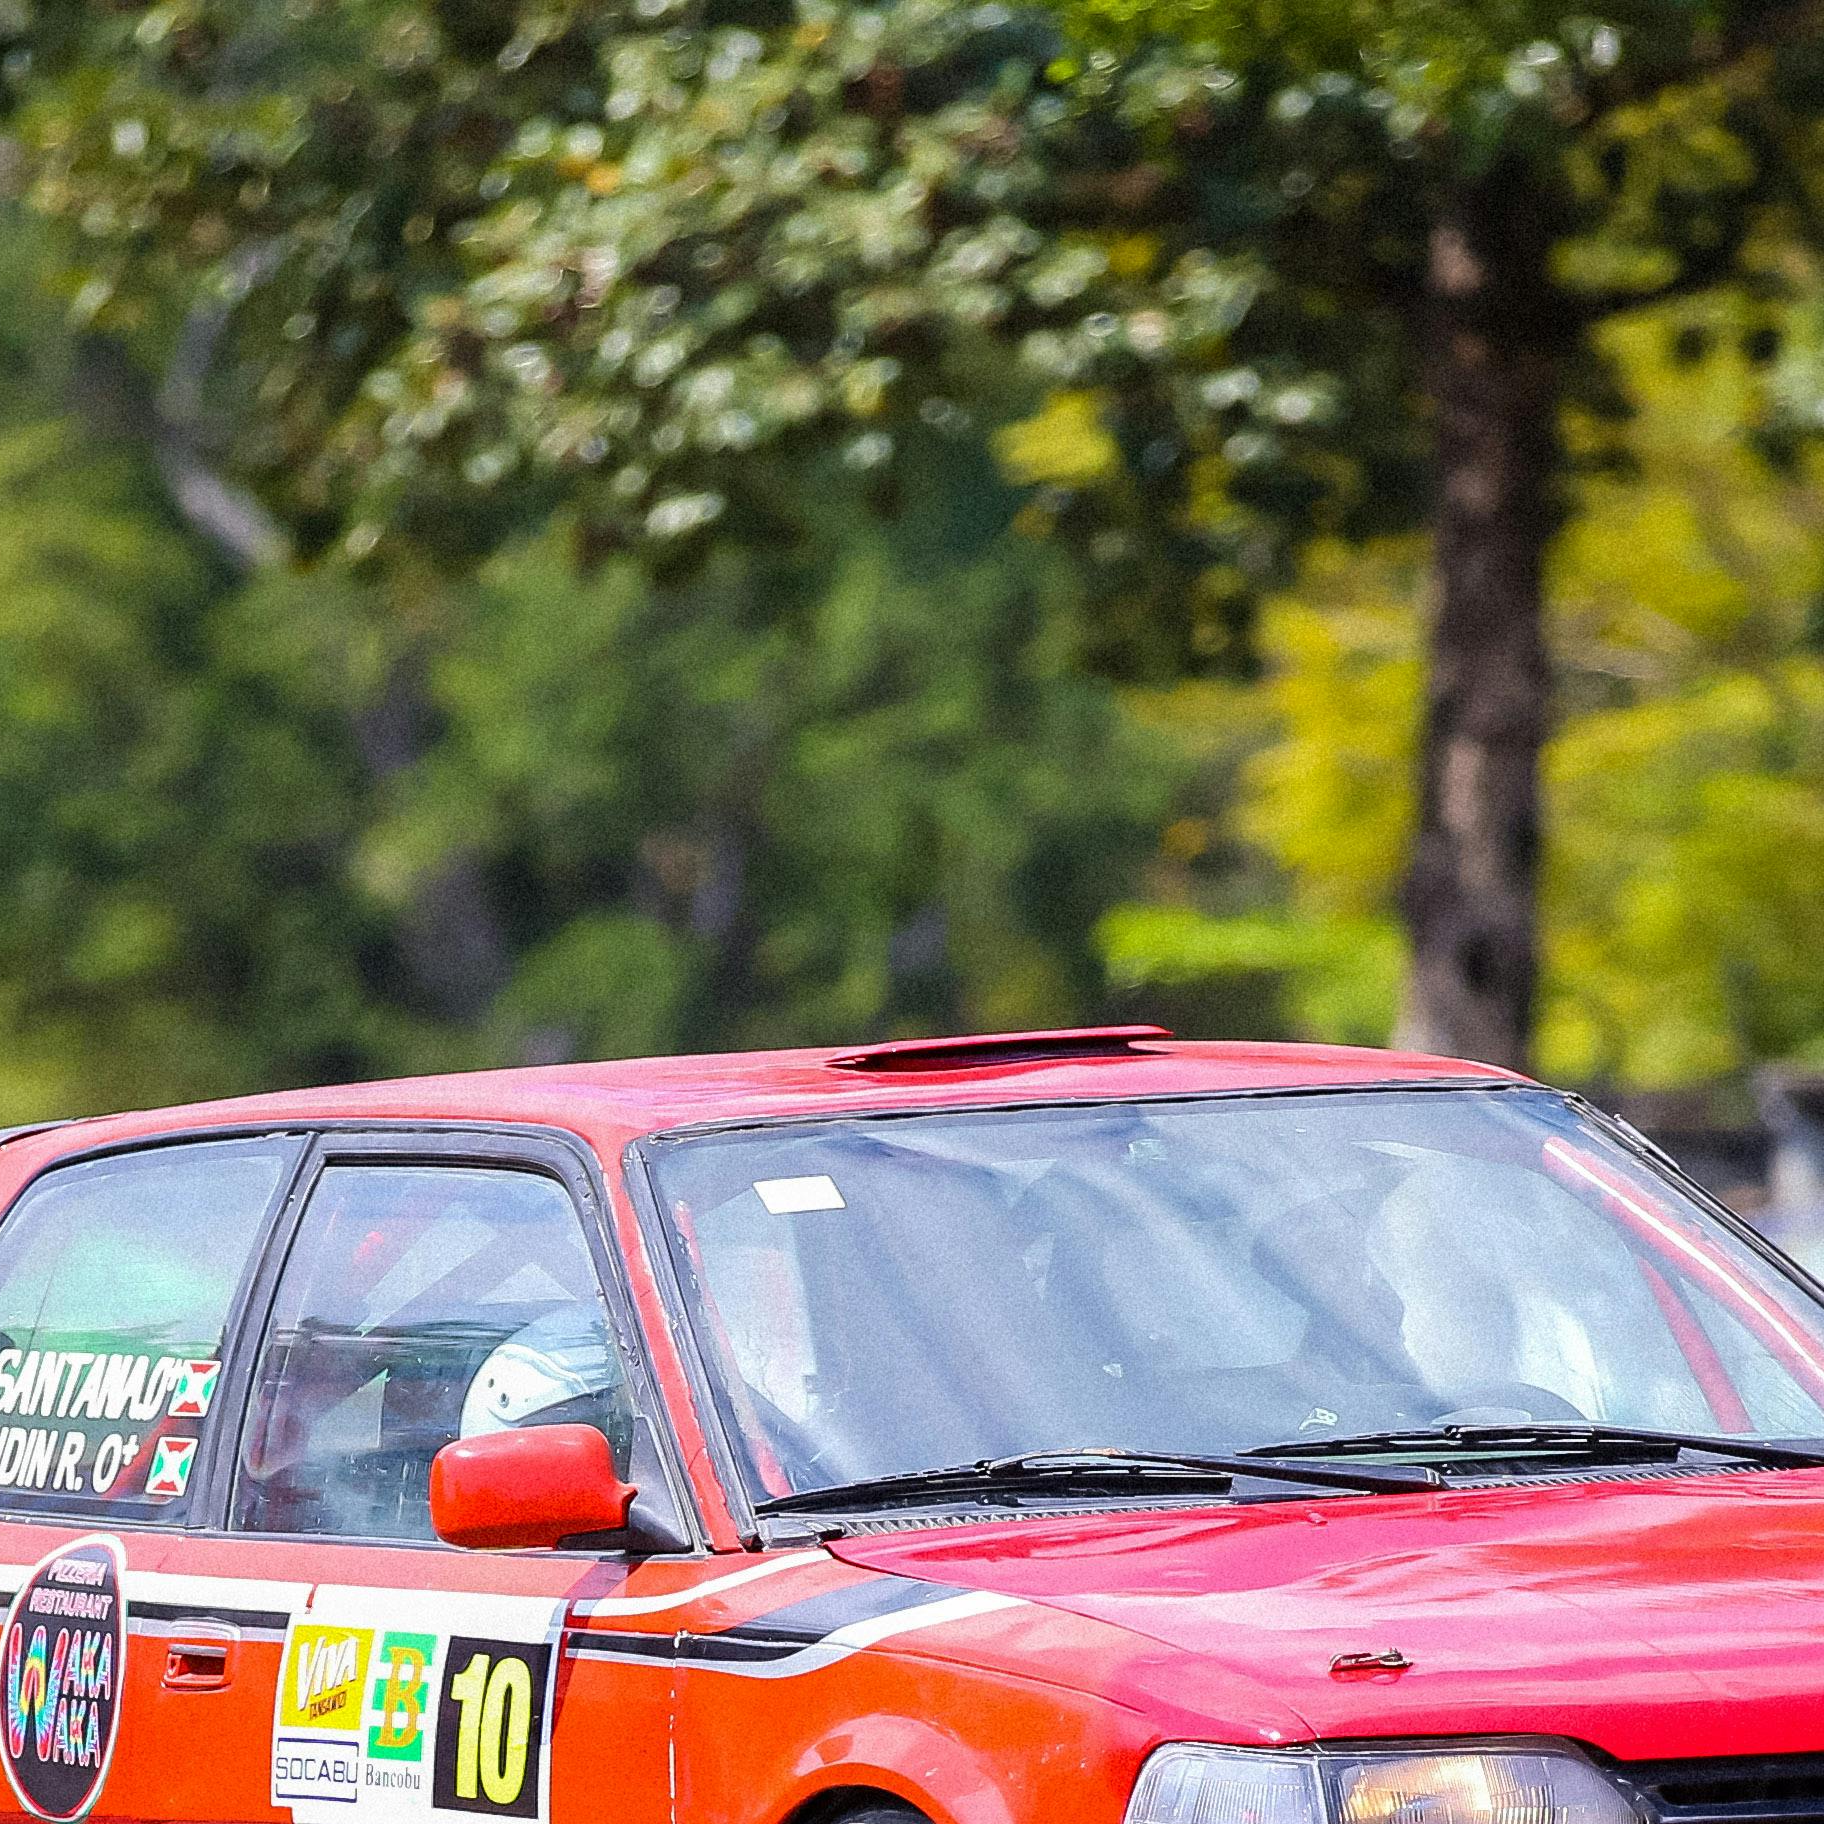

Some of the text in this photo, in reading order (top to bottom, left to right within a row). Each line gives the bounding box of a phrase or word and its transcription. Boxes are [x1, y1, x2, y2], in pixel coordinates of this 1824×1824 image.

[52, 1431, 86, 1492] R.
[28, 1586, 114, 1621] RESTAURANT
[297, 1636, 358, 1711] VIVA
[450, 1653, 534, 1806] 10
[276, 1756, 358, 1784] SOCABU
[365, 1763, 421, 1790] Bancobu
